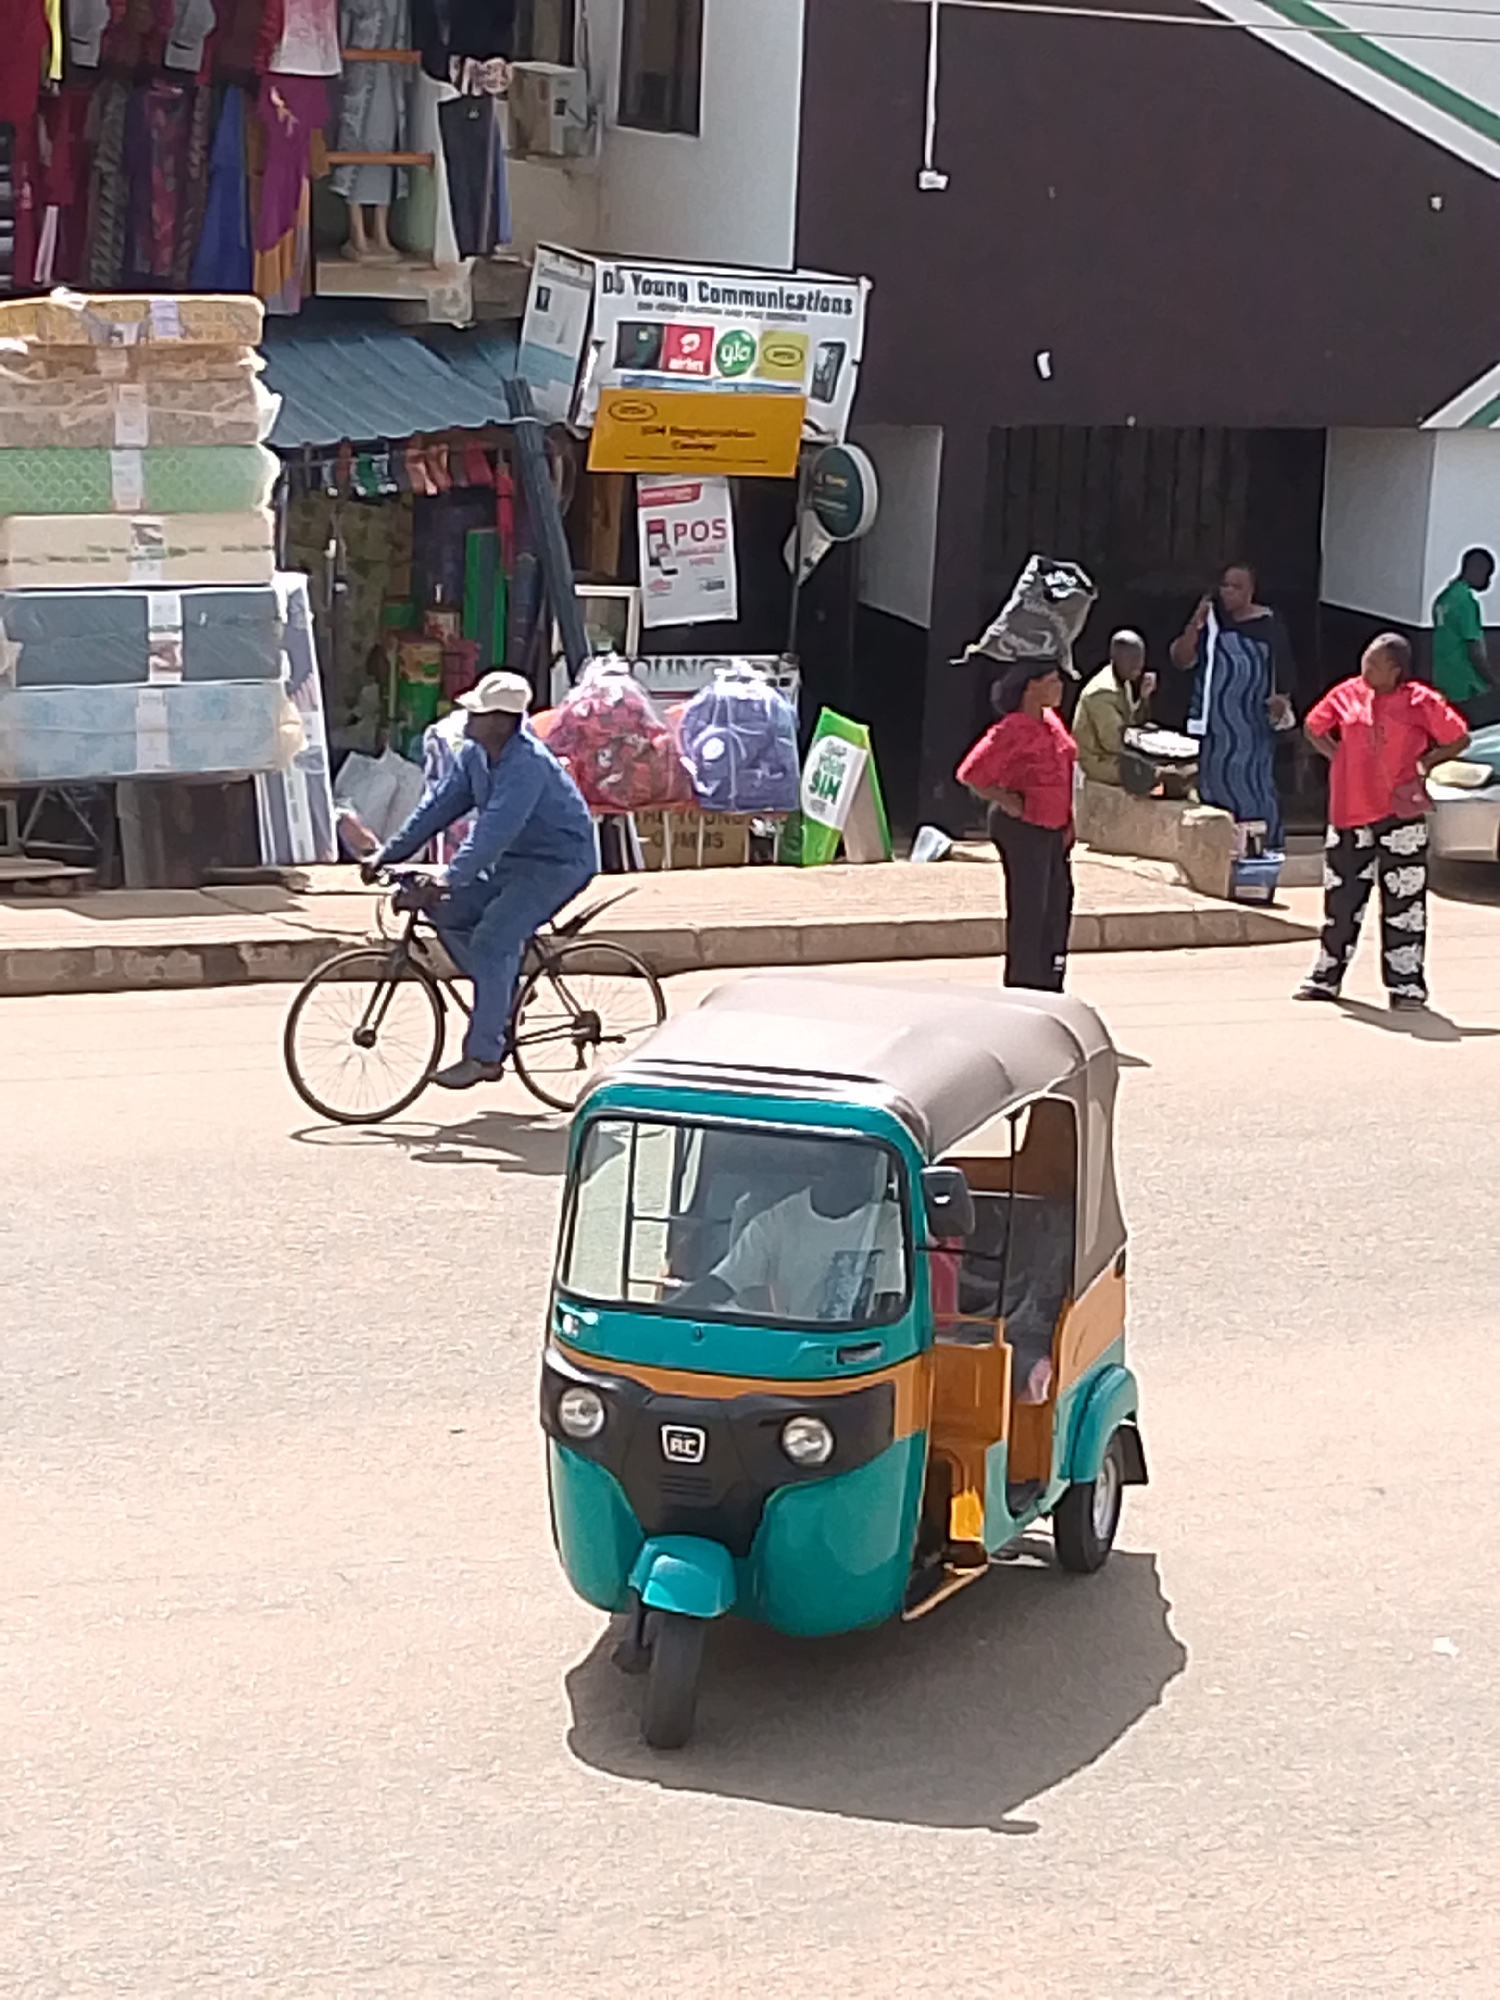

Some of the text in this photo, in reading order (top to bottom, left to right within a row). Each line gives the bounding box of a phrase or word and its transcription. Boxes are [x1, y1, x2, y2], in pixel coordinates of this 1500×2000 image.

[630, 272, 689, 303] Young
[697, 279, 853, 315] Communications
[720, 341, 750, 366] glo
[674, 518, 727, 546] POS
